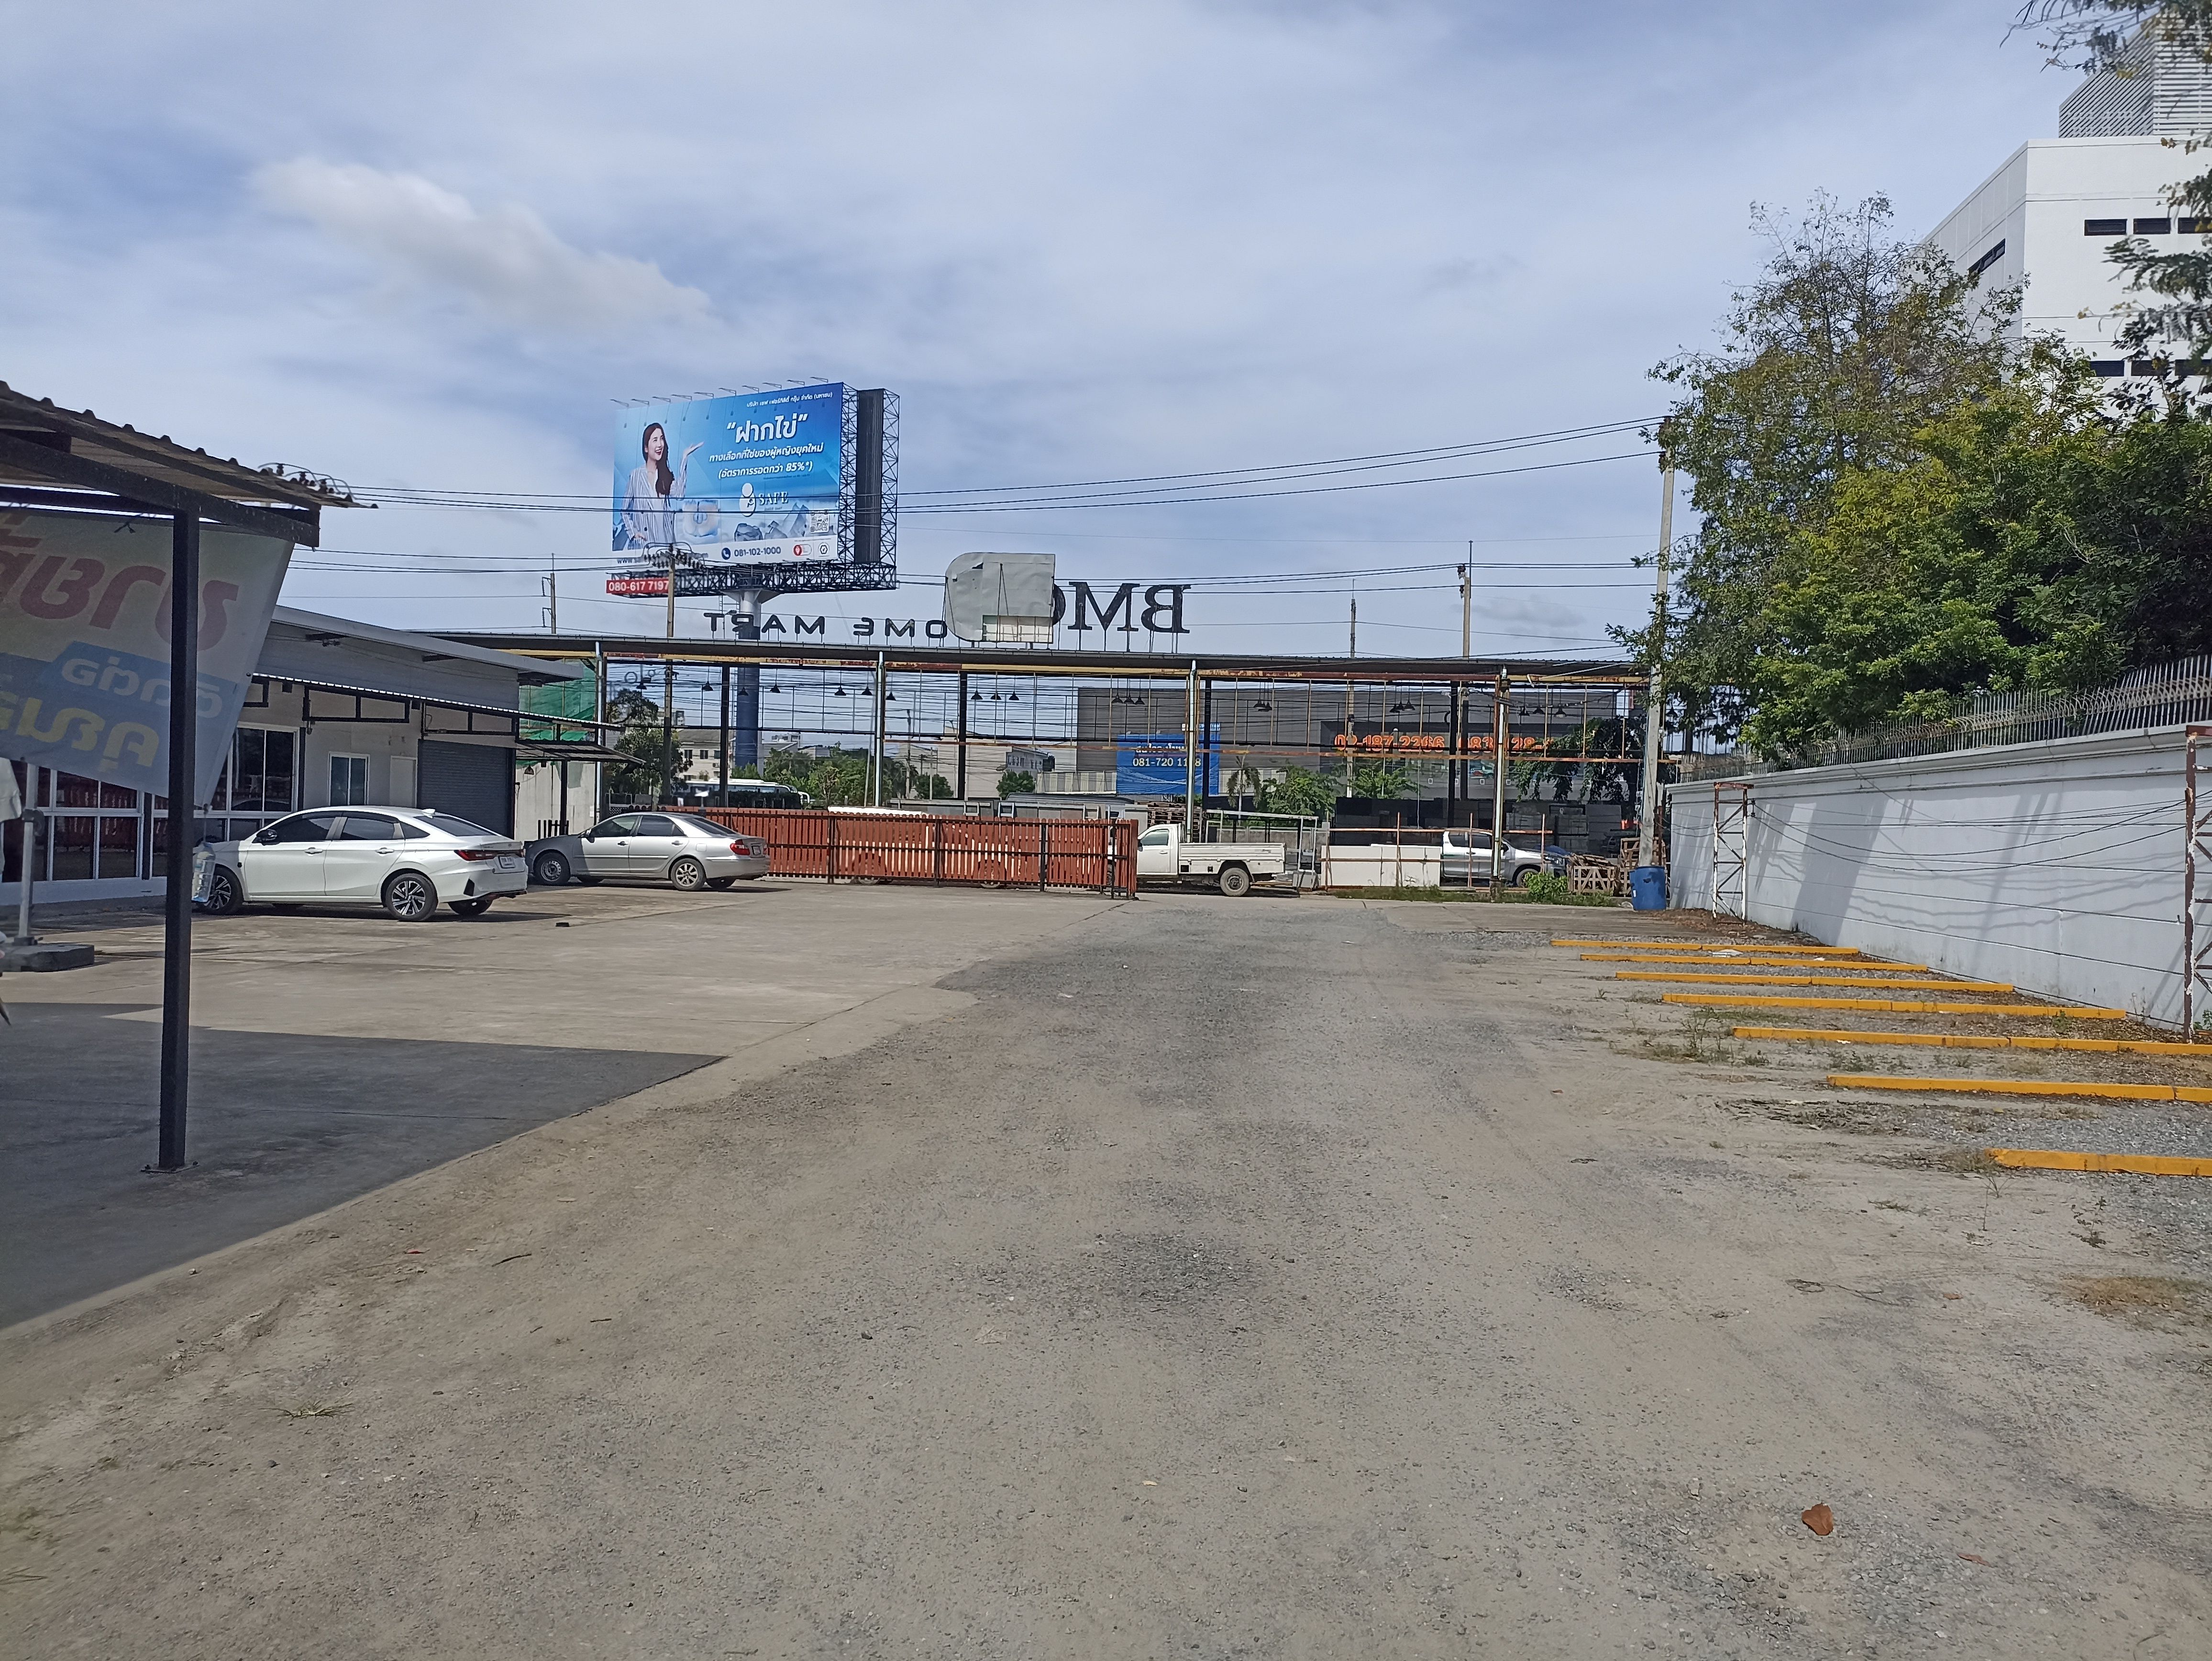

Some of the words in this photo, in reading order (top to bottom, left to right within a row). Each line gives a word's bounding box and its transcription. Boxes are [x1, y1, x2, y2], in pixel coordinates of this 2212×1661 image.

[709, 442, 824, 462] ทางเลือกที่ใช่ของผู้หญิงยุคใหม่
[758, 491, 789, 506] SAFE
[734, 546, 781, 557] 081-102-1000
[608, 581, 646, 591] 080-617
[648, 580, 669, 590] 7197
[1132, 757, 1173, 766] 081-720
[1177, 757, 1201, 766] 118
